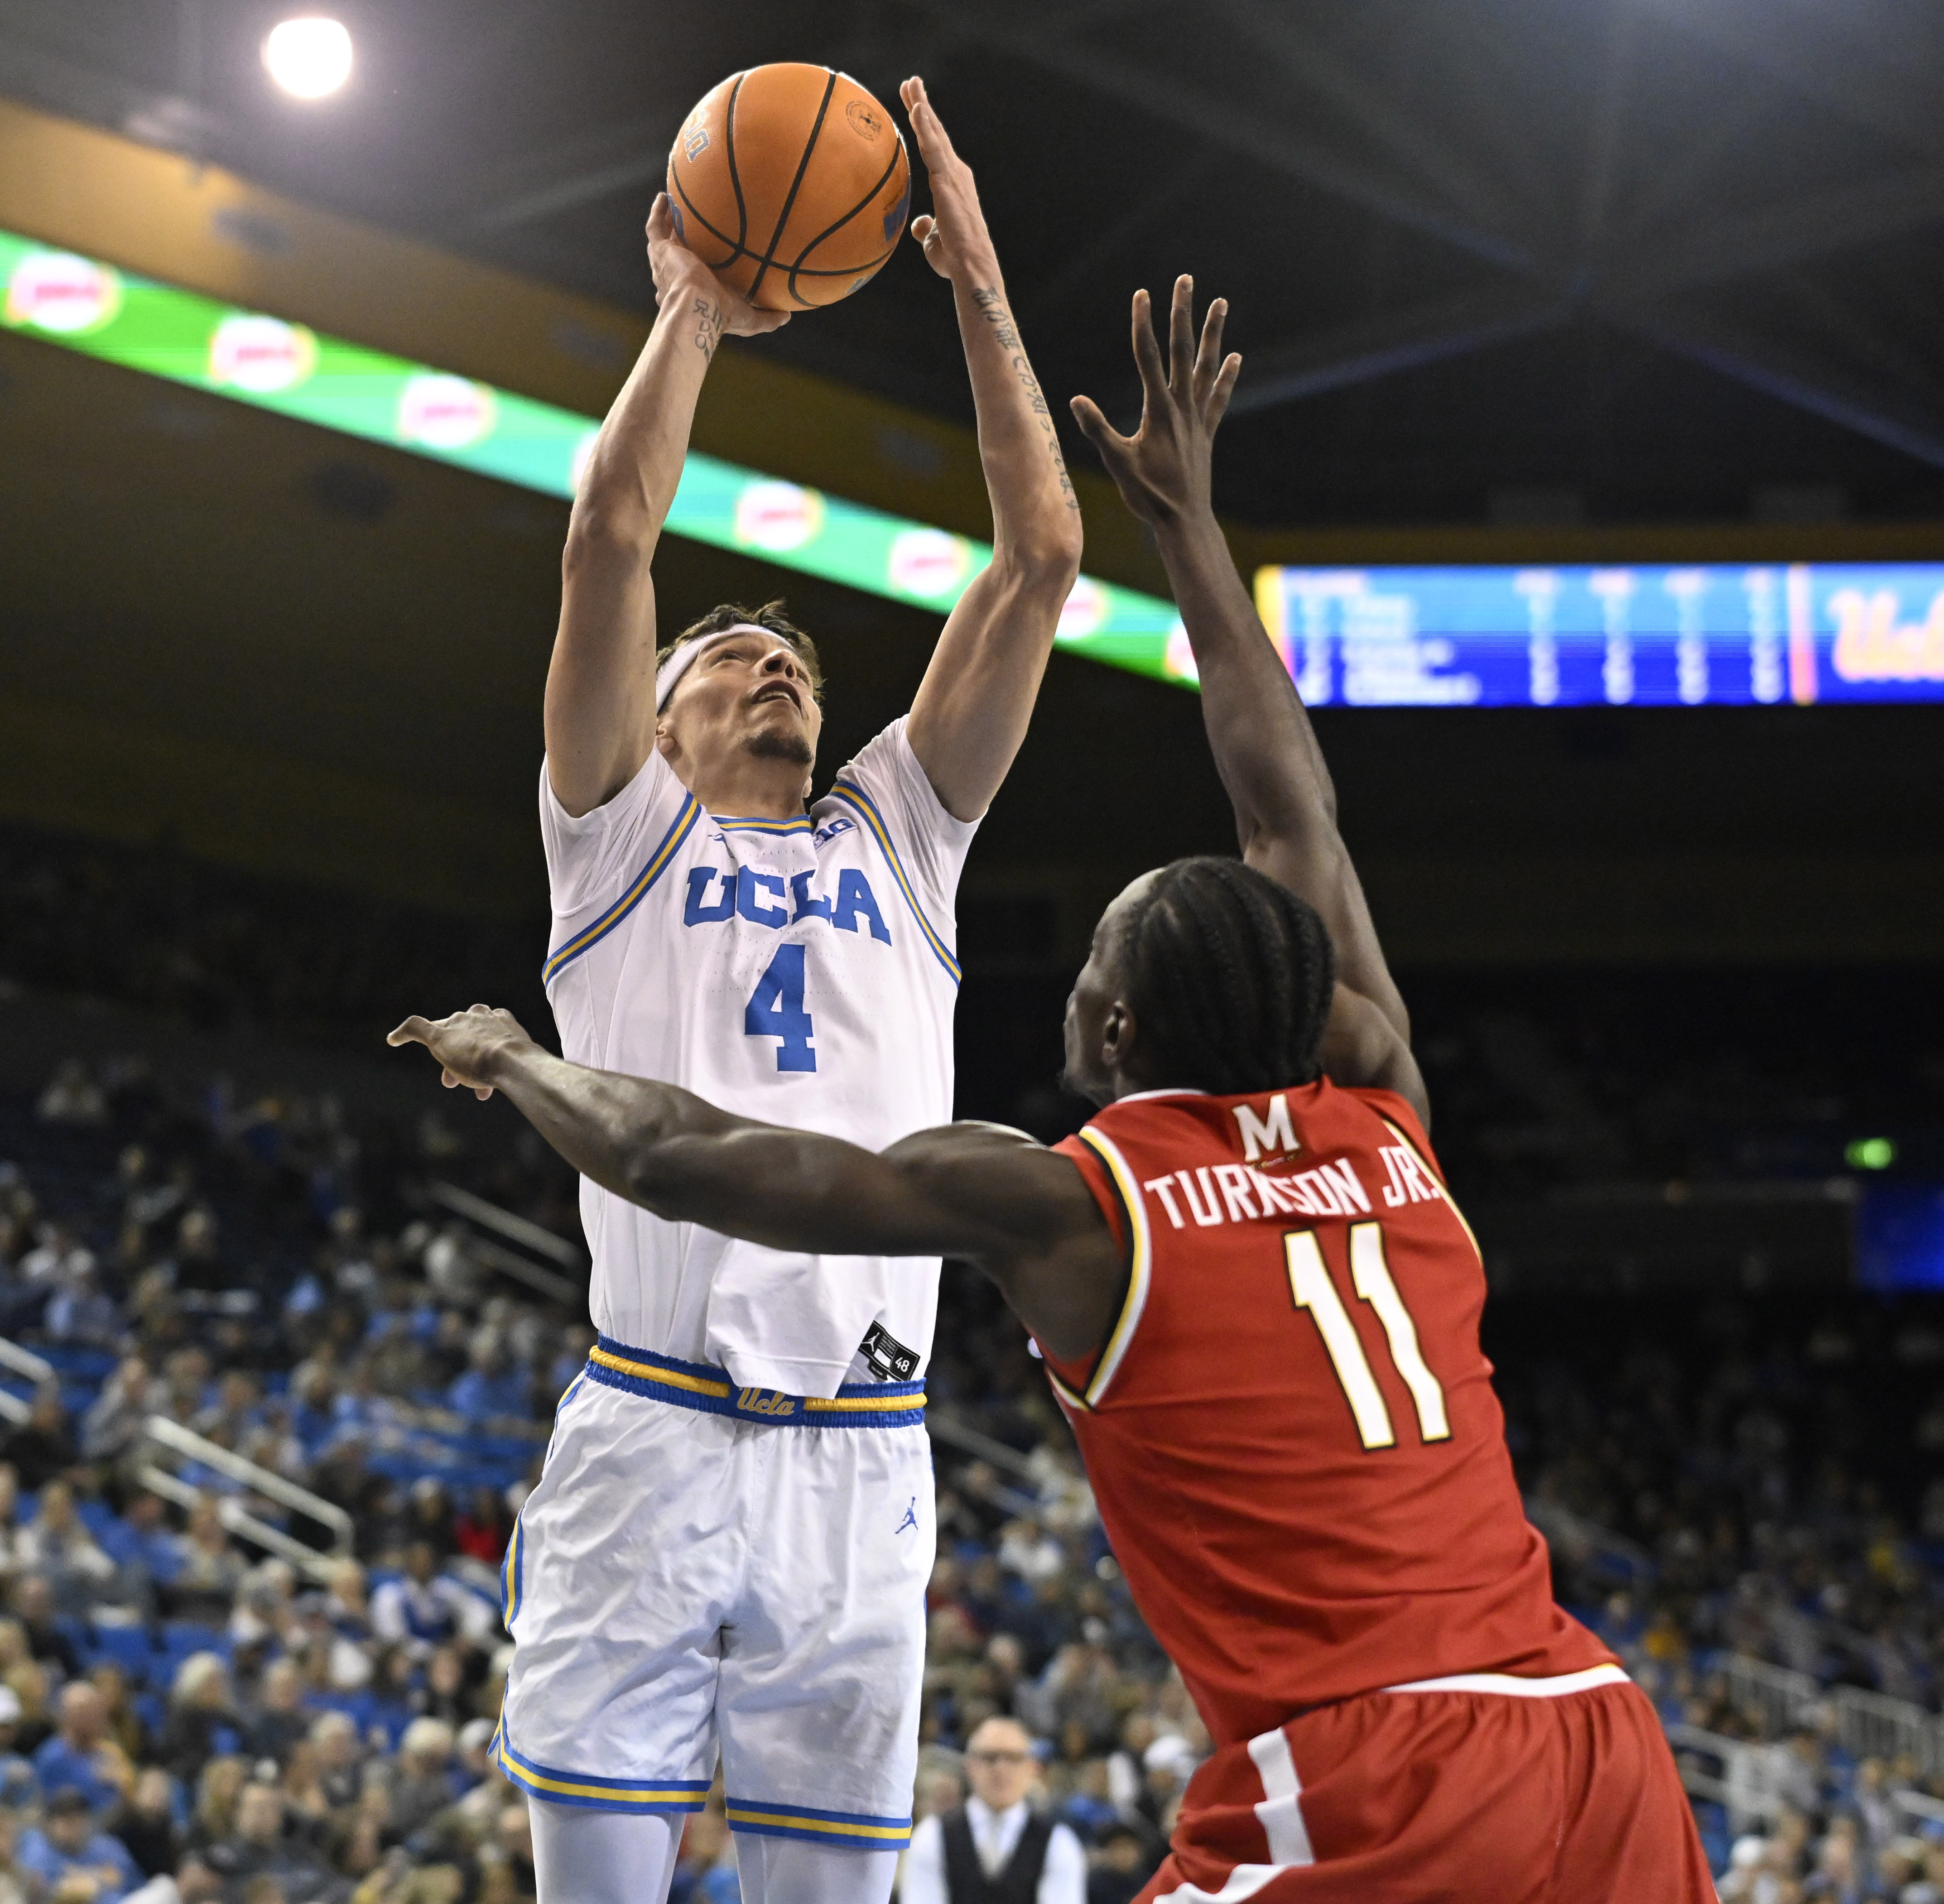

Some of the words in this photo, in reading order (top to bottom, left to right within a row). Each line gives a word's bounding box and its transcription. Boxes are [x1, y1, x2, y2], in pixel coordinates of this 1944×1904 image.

[683, 864, 892, 947] UCLA
[744, 943, 817, 1072] 4
[1231, 1093, 1301, 1163] M
[1144, 1157, 1372, 1229] TURKSON
[895, 1357, 910, 1372] 48
[1281, 1220, 1453, 1451] 11
